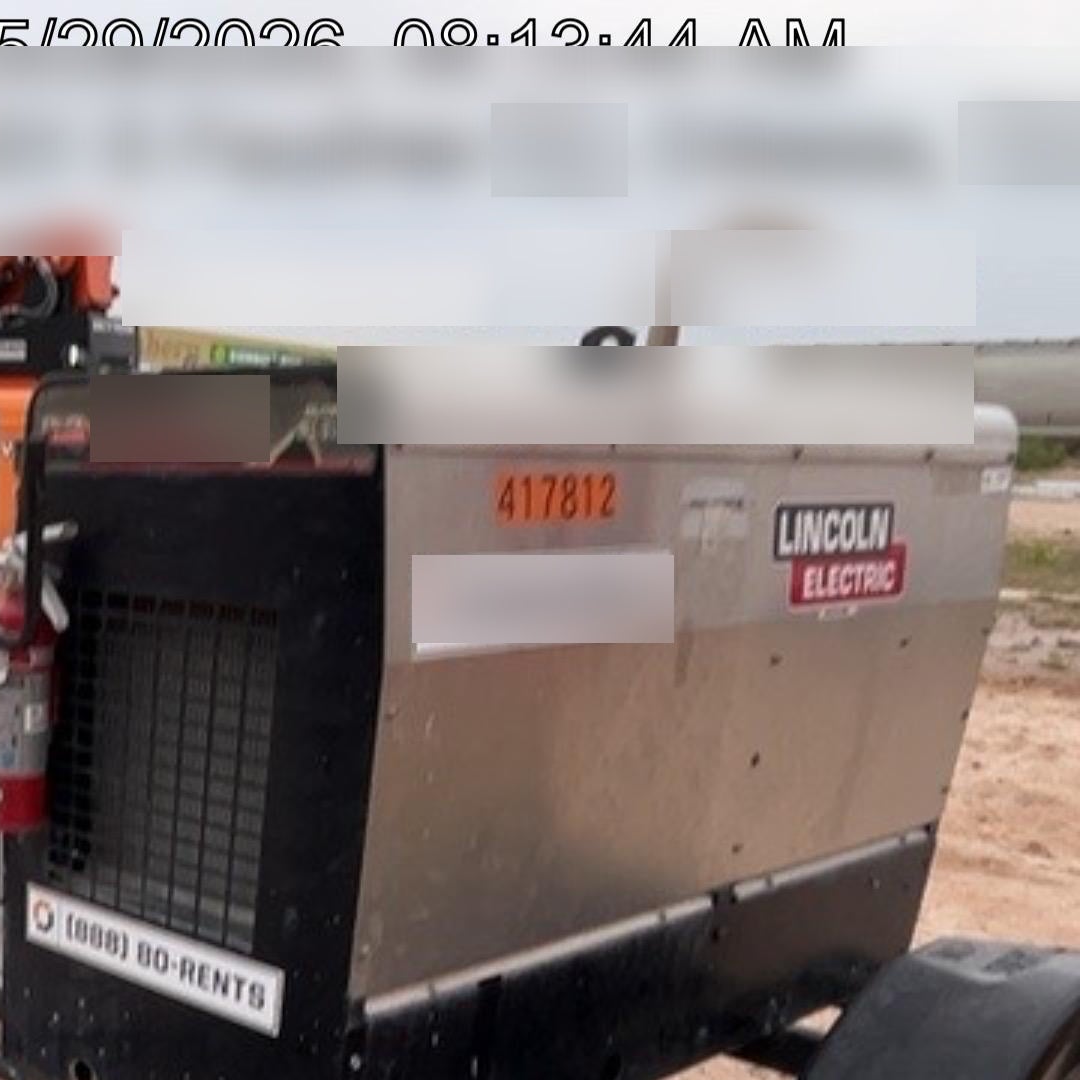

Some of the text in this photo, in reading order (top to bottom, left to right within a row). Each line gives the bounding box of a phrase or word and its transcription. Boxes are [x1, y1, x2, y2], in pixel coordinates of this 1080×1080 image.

[497, 473, 616, 521] 417812
[778, 508, 890, 556] LINCOLN
[802, 559, 898, 600] ELECTRIC
